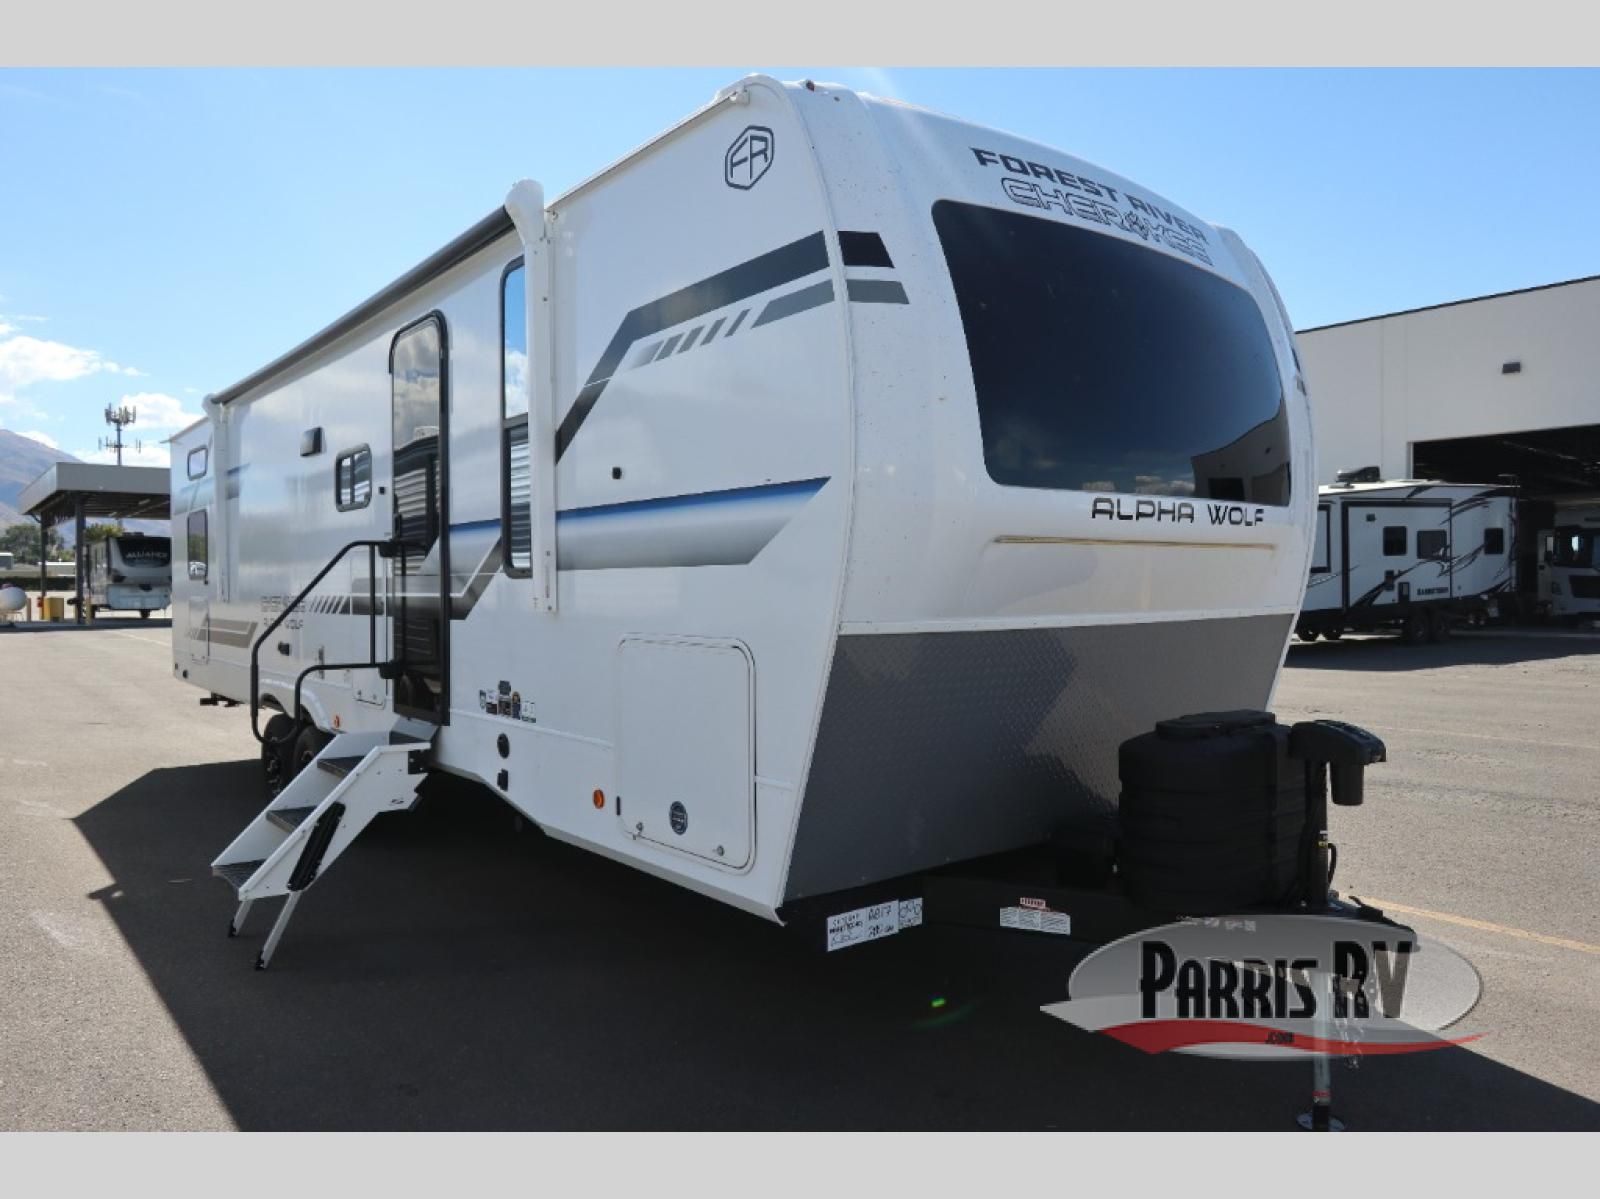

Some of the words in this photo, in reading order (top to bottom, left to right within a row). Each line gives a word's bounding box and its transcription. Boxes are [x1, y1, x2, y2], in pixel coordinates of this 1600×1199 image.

[969, 147, 1118, 201] FOREST
[1124, 193, 1211, 245] RIVER
[1091, 497, 1195, 523] ALPHA
[1207, 503, 1265, 526] WOLF
